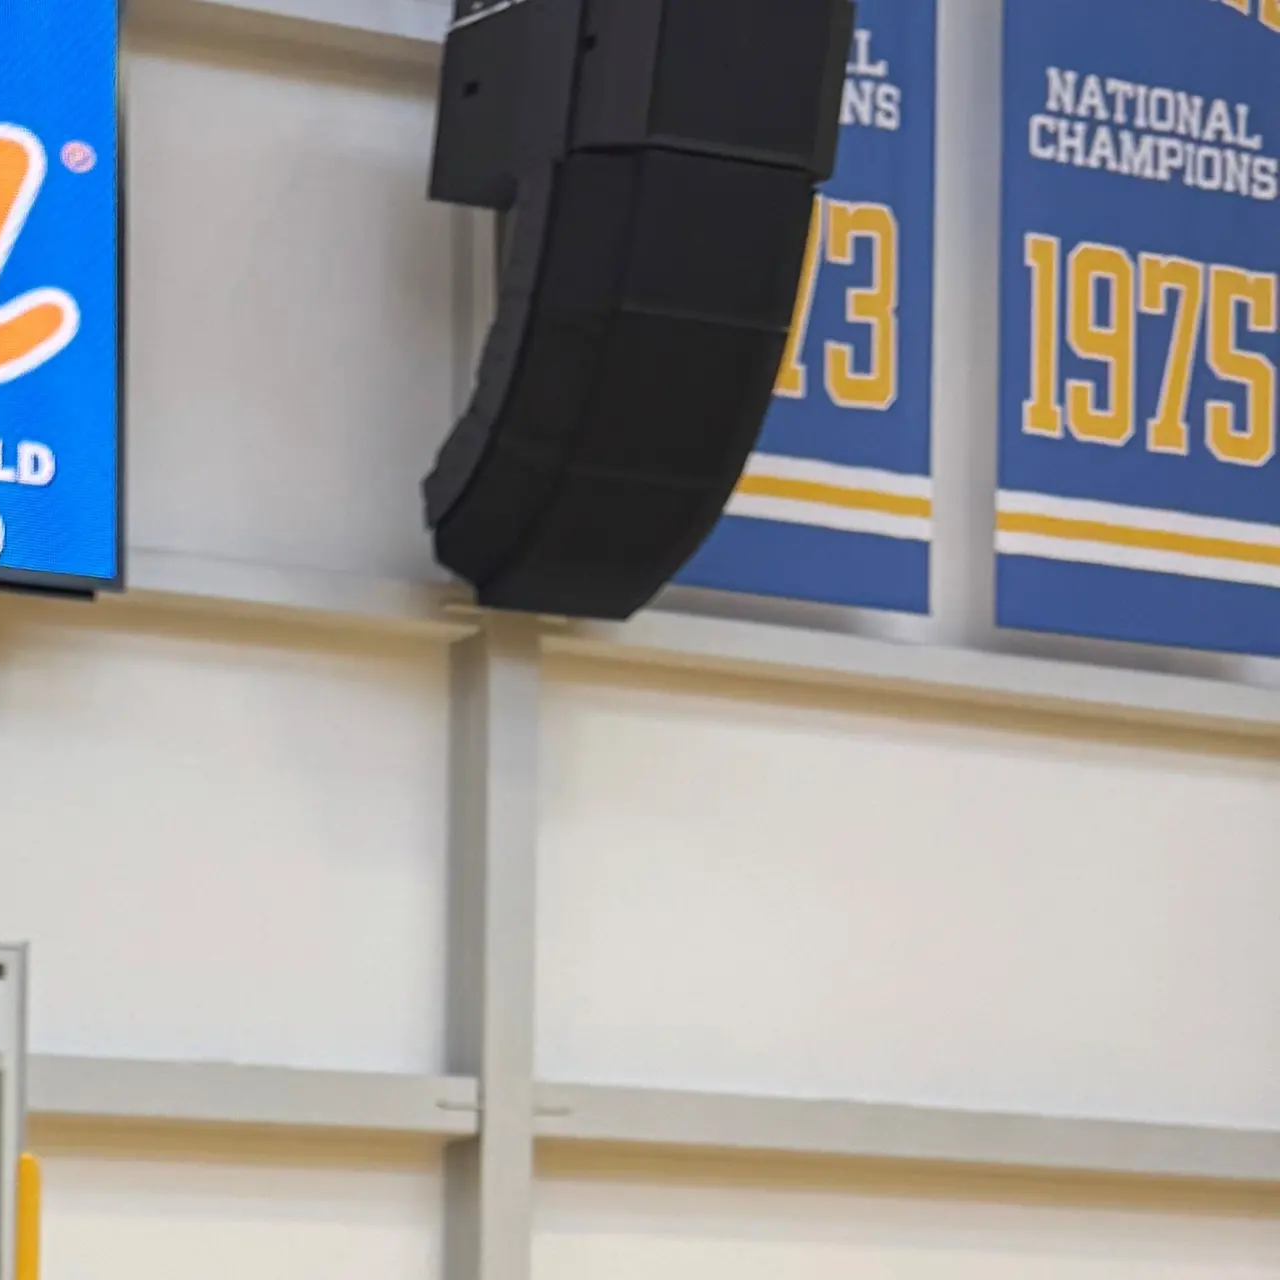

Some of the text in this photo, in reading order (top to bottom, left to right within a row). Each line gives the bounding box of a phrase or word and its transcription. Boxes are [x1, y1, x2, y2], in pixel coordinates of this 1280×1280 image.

[1045, 67, 1263, 150] NATIONAL
[1029, 115, 1279, 200] CHAMPIONS
[1022, 233, 1278, 467] 1975
